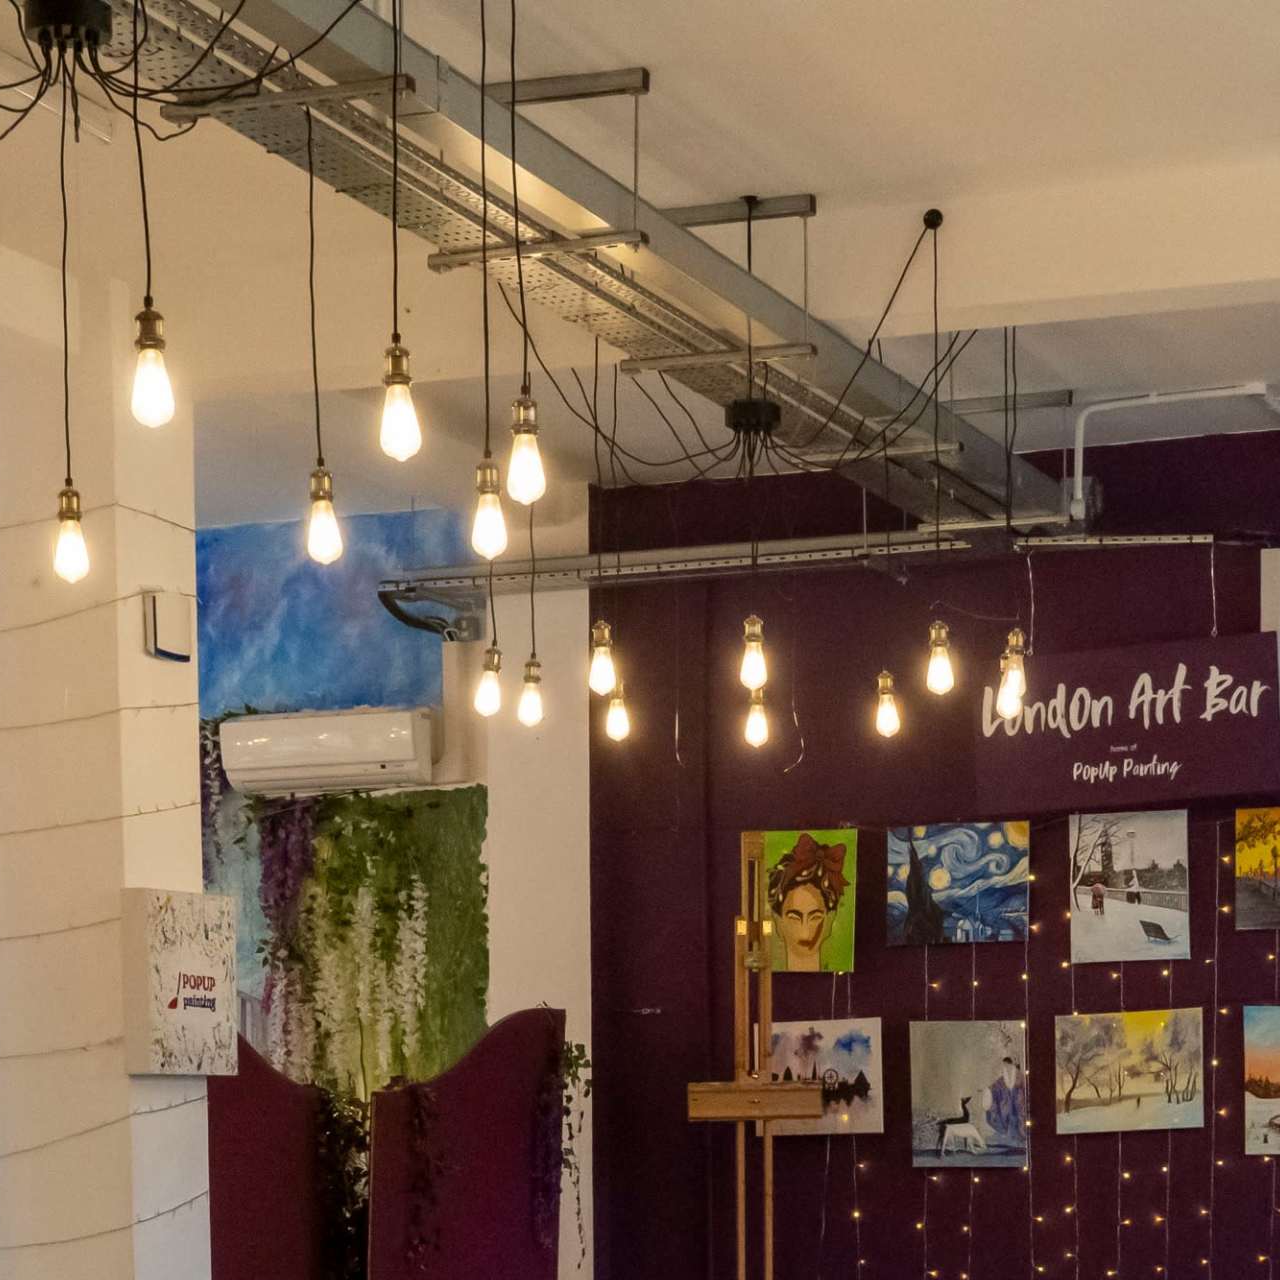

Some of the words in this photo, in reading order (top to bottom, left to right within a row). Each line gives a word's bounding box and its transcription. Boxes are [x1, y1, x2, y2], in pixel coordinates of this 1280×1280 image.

[1128, 662, 1193, 730] Art
[1199, 665, 1273, 722] Bar
[1123, 753, 1182, 780] Painting
[182, 973, 216, 992] POPUP
[183, 994, 216, 1012] painting
